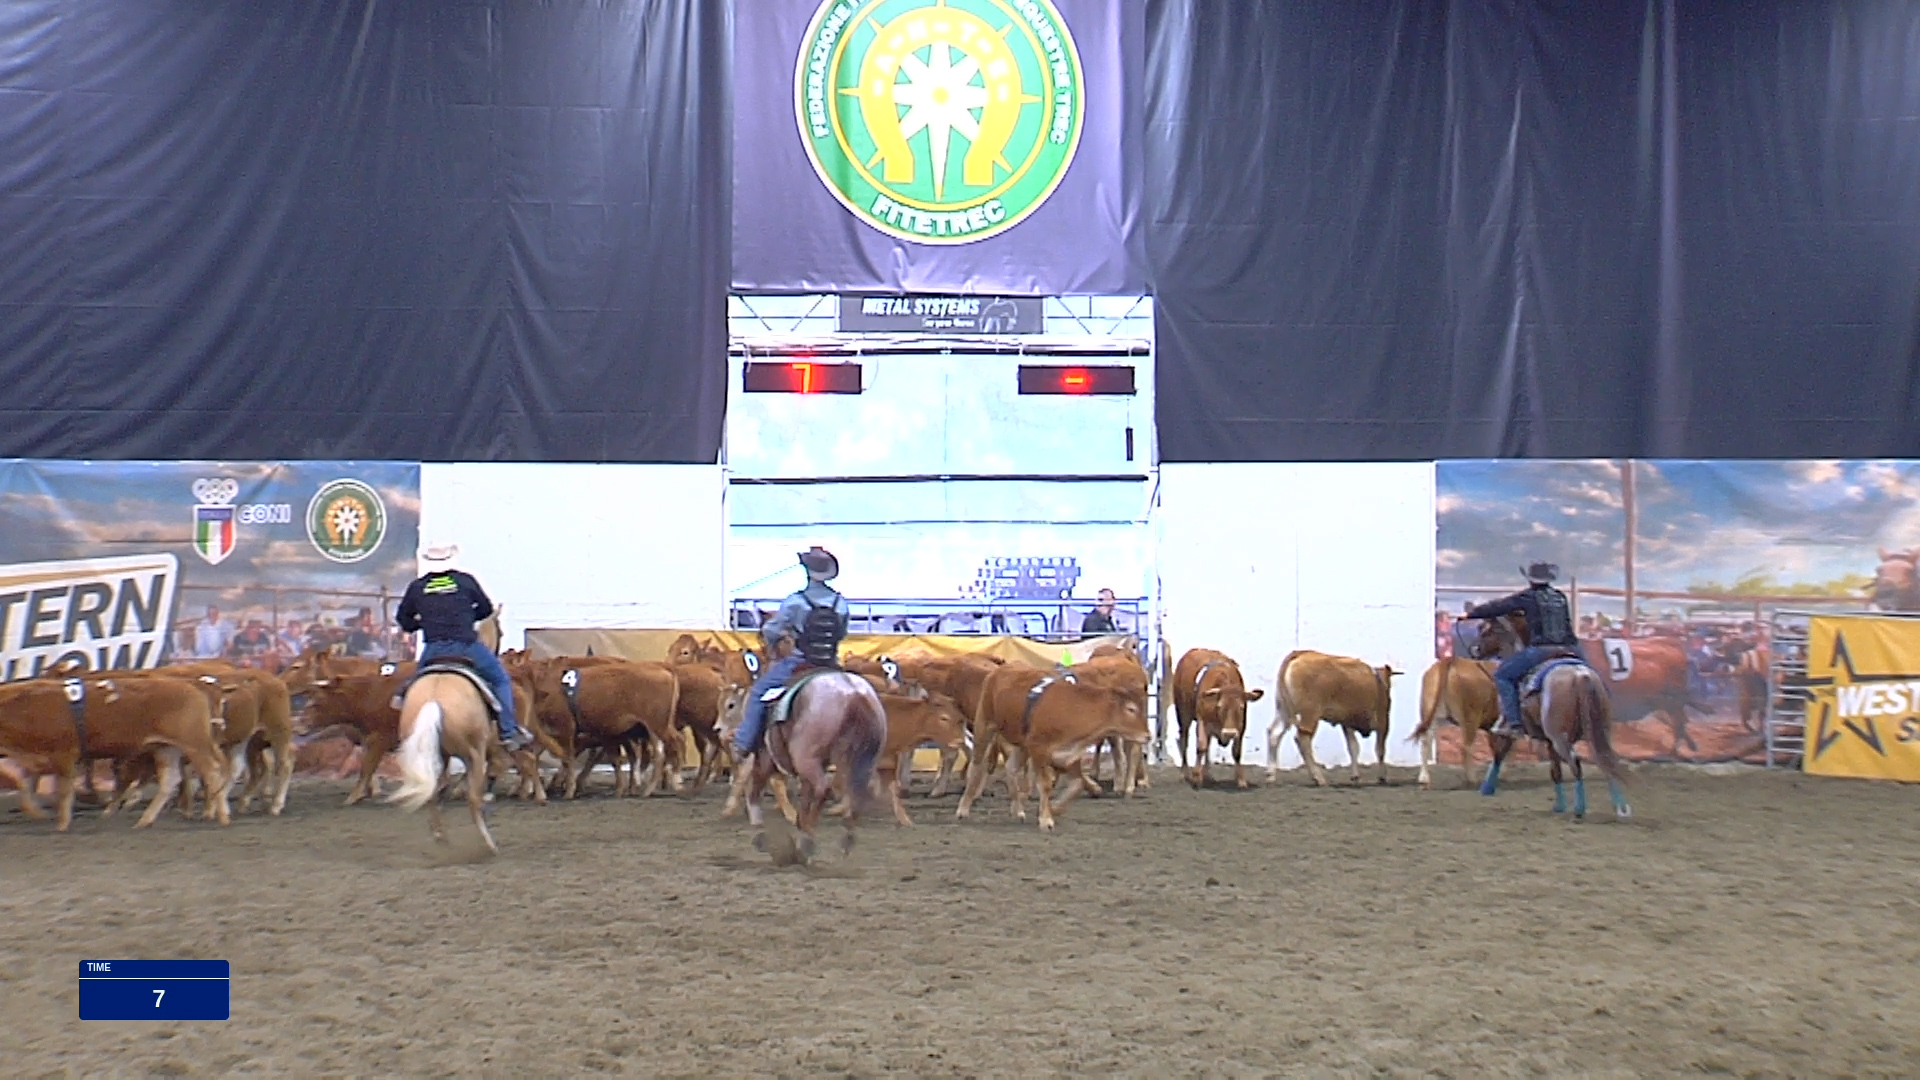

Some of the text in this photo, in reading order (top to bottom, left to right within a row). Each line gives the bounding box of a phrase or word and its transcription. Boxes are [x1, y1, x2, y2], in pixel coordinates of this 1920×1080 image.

[870, 193, 1006, 235] FITETREC
[862, 297, 981, 317] METAL SYSTEMS
[792, 362, 812, 393] 7
[238, 504, 292, 523] CONI
[0, 573, 167, 650] TERN
[881, 662, 897, 680] 9
[1610, 647, 1629, 673] 1
[562, 670, 577, 688] 4
[1837, 681, 1920, 717] WEST
